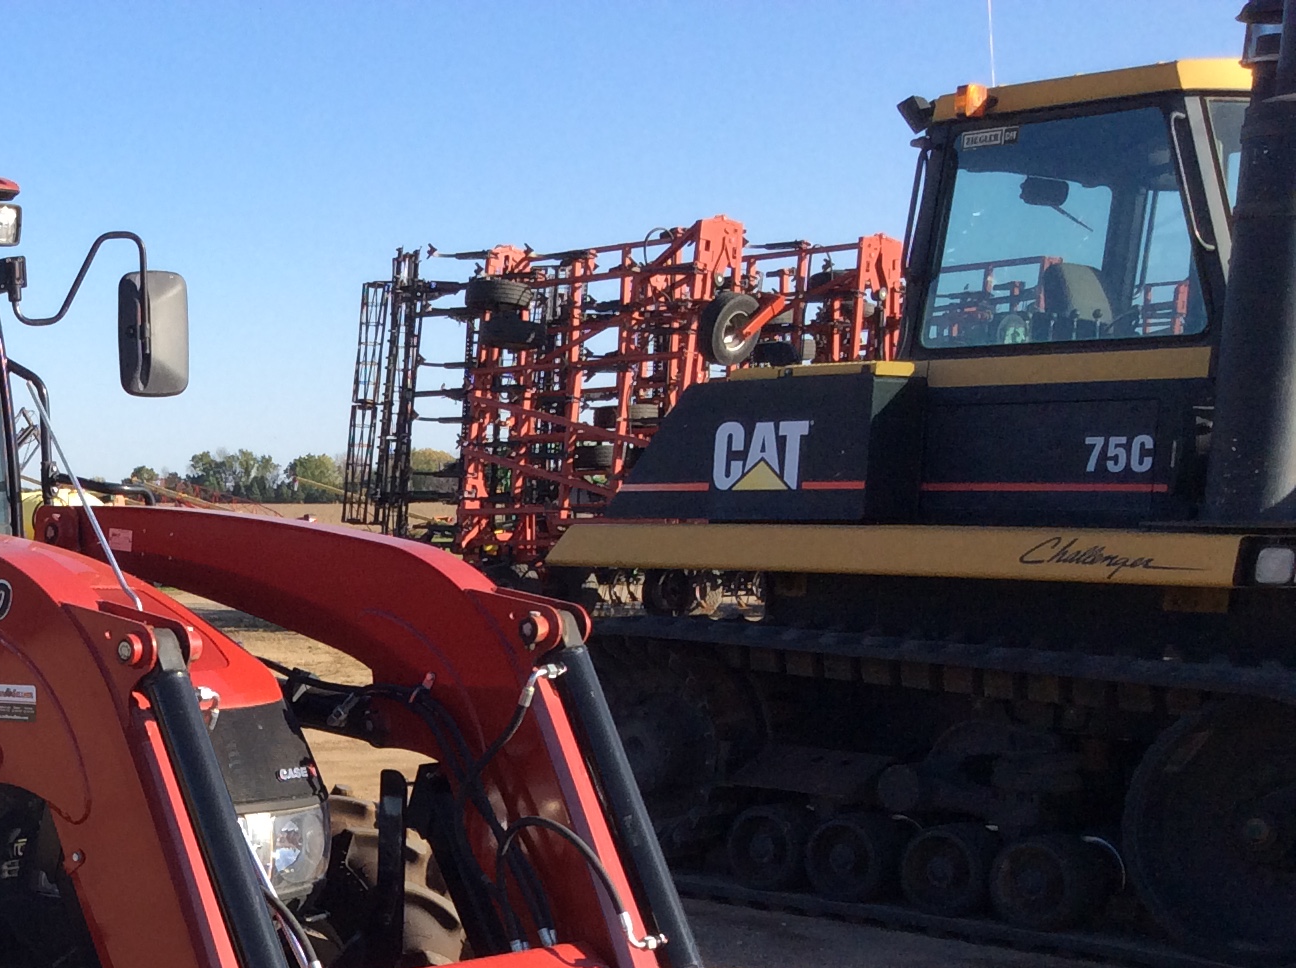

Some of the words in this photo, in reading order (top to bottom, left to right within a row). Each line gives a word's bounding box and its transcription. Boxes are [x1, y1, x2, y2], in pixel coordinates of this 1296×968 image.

[713, 421, 809, 490] CAT
[1084, 435, 1154, 473] 75C
[1019, 536, 1200, 579] Challenger
[279, 766, 308, 780] CASE
